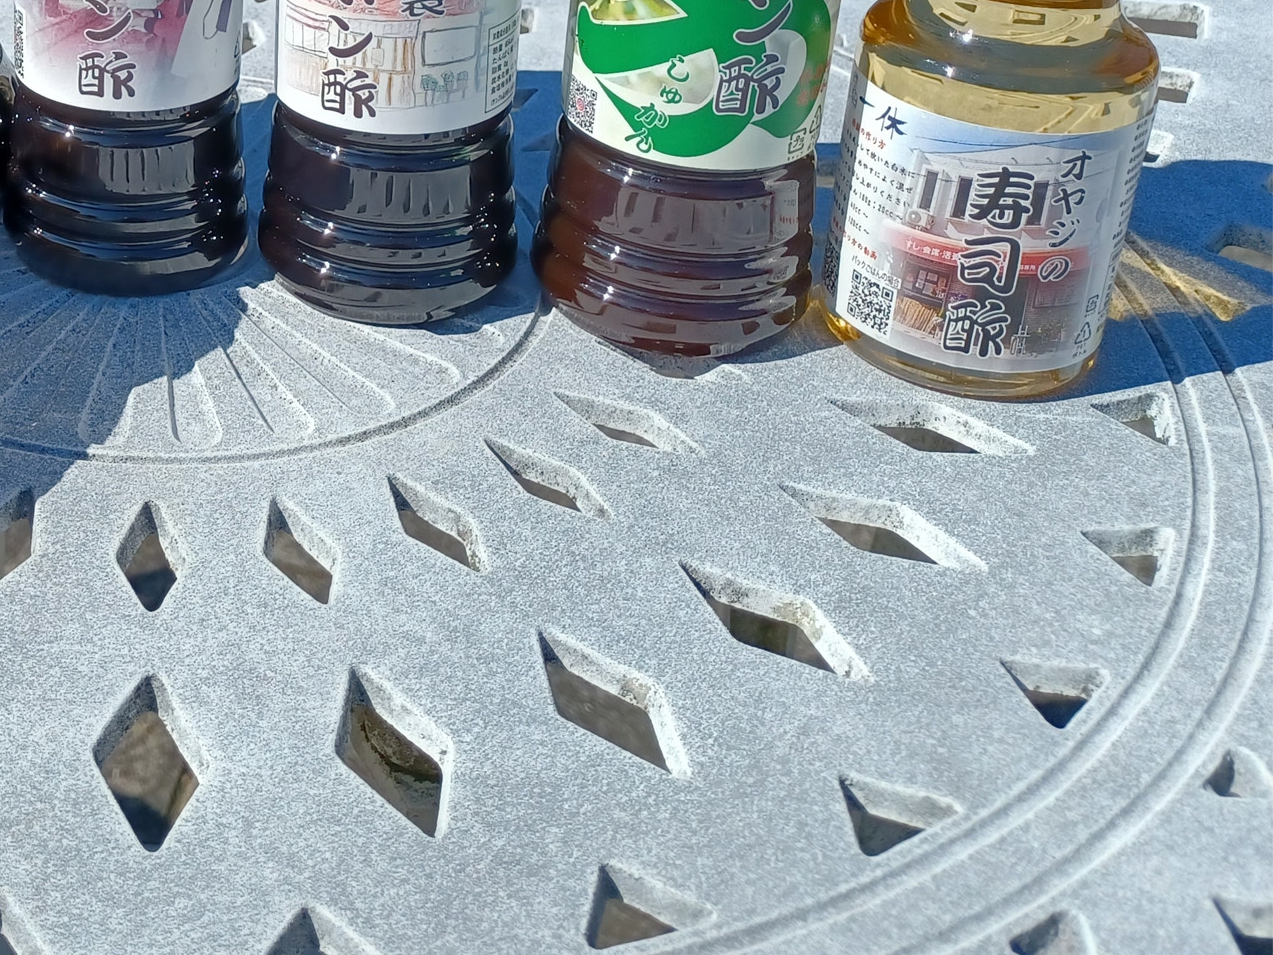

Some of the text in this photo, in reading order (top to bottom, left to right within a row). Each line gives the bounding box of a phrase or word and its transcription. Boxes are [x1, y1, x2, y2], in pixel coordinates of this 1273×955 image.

[859, 95, 908, 140] 一休
[1038, 150, 1092, 282] オヤジの
[852, 255, 901, 287] パックごはんの場合
[941, 166, 1037, 358] 寿司酢
